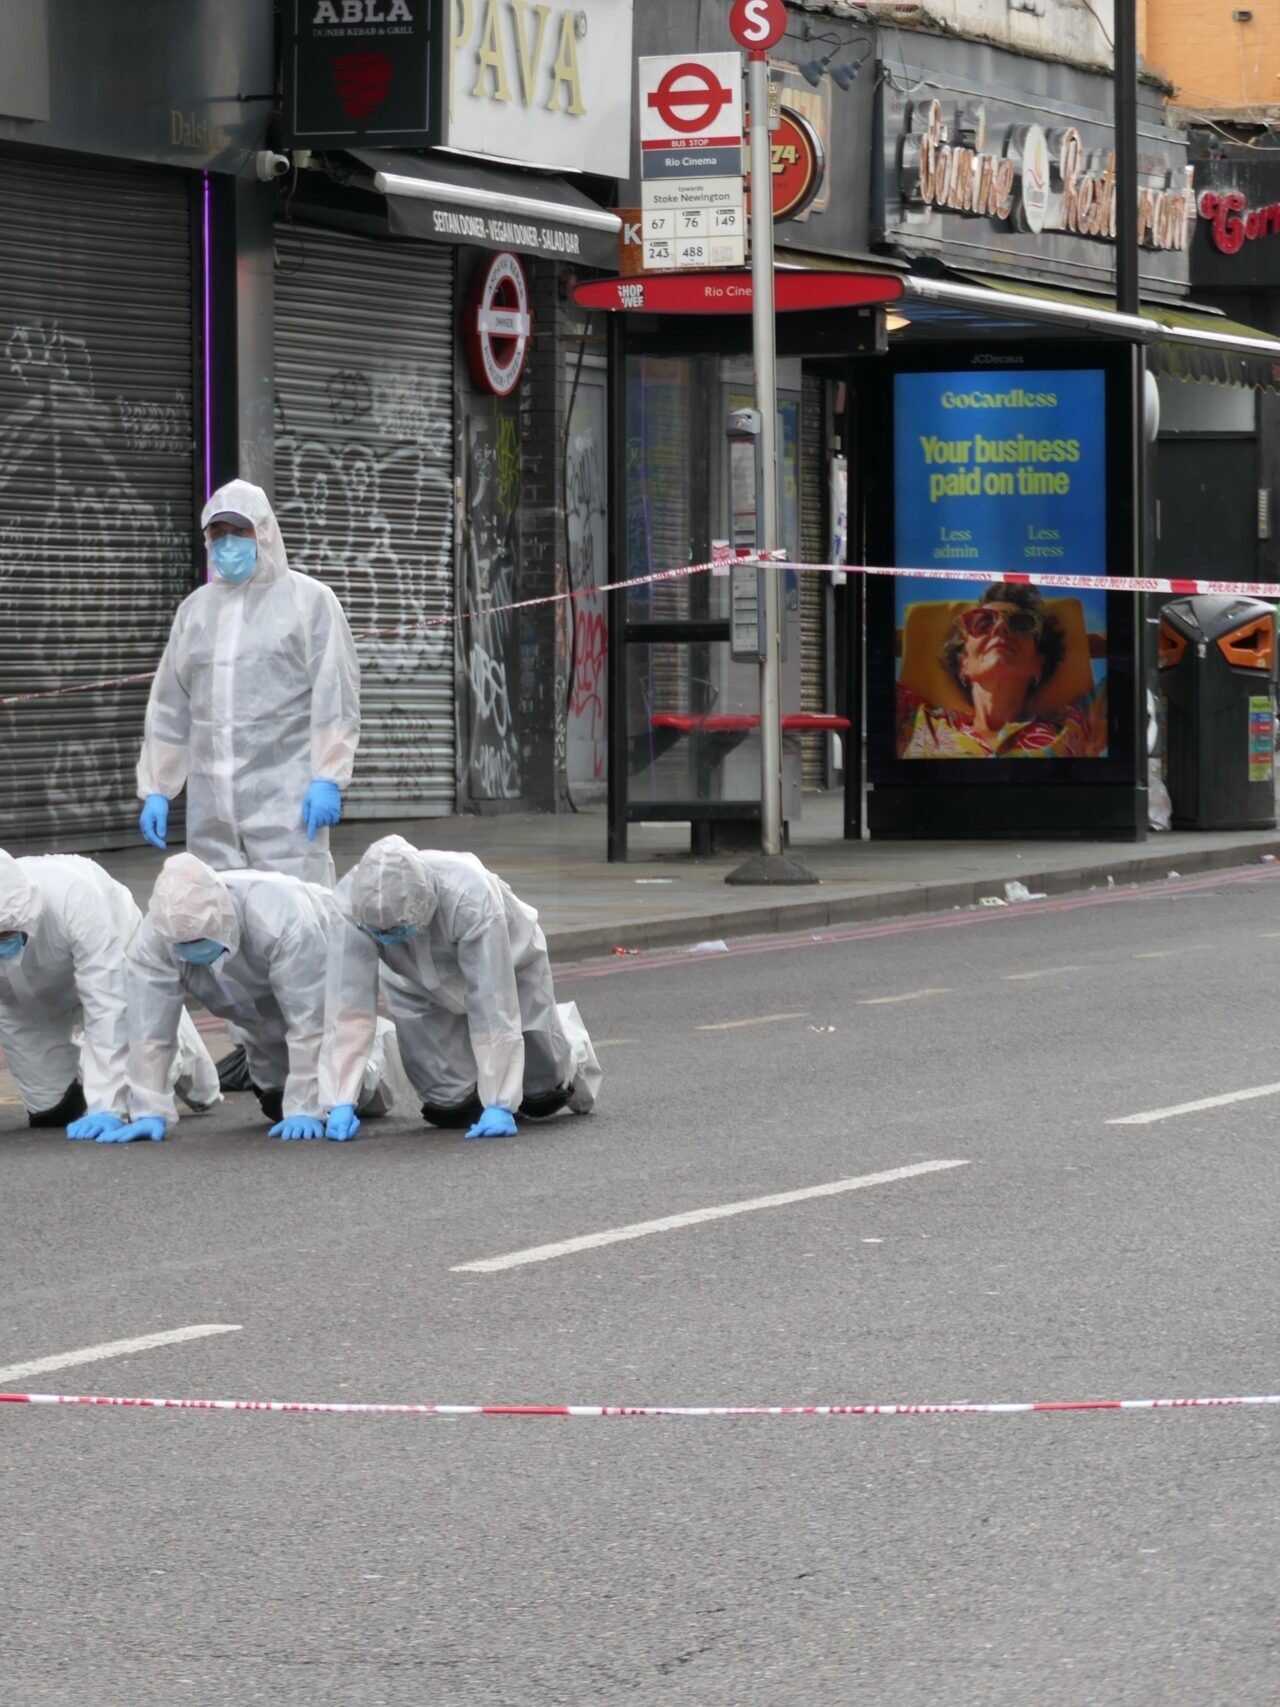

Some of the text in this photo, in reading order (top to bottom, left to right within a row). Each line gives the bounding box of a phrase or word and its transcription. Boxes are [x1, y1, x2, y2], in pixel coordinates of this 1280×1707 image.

[313, 0, 413, 24] ABLA
[744, 0, 770, 41] S
[313, 29, 345, 37] DONER
[387, 26, 414, 35] GRILL
[671, 138, 709, 148] BUS STOP
[665, 157, 717, 167] Rio Cinema
[653, 192, 730, 203] Stoke Newington
[651, 216, 735, 229] 67 76 149
[433, 210, 580, 254] SEITAN DONER VEGAN DONER SALAD BAR
[649, 248, 670, 259] 243
[682, 247, 703, 257] 488
[705, 286, 752, 297] Rio Cine
[940, 389, 1058, 408] GoCardless
[920, 434, 1080, 464] Your business
[930, 466, 1070, 503] paid on time
[940, 527, 972, 541] Less
[1028, 526, 1060, 540] Less
[934, 545, 978, 558] admin
[1024, 544, 1064, 557] stress
[1039, 575, 1071, 585] POLICE
[1072, 576, 1092, 586] LINE
